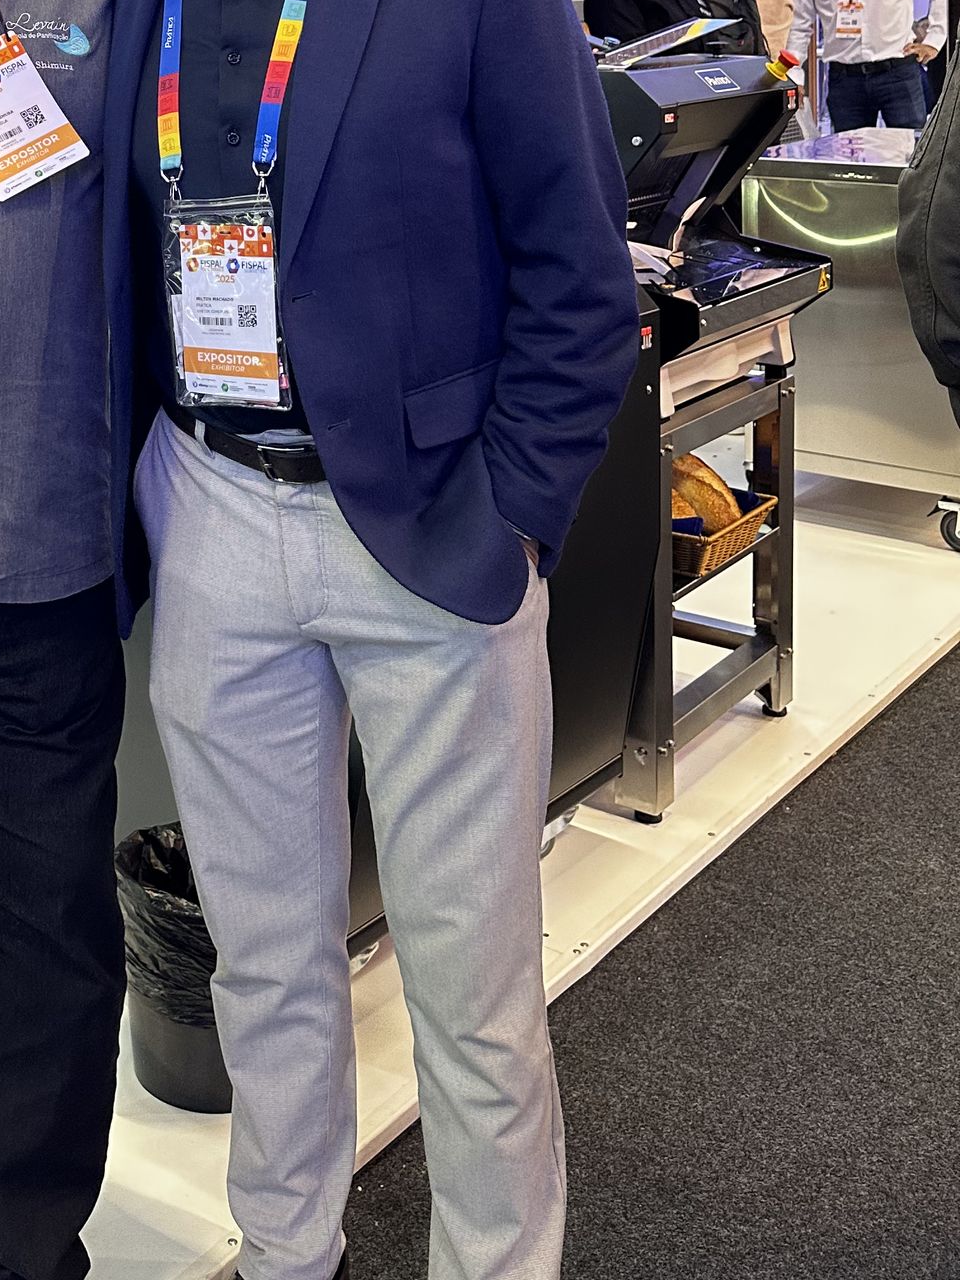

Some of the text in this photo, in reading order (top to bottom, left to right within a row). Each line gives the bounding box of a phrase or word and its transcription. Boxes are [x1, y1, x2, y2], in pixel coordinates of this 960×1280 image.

[0, 59, 27, 77] FISPAL
[16, 147, 50, 169] EXHIBITOR
[241, 260, 268, 270] FISPAL
[215, 274, 236, 284] 2025
[197, 351, 262, 367] EXPOSITOR
[211, 363, 246, 372] EXHIBITOR
